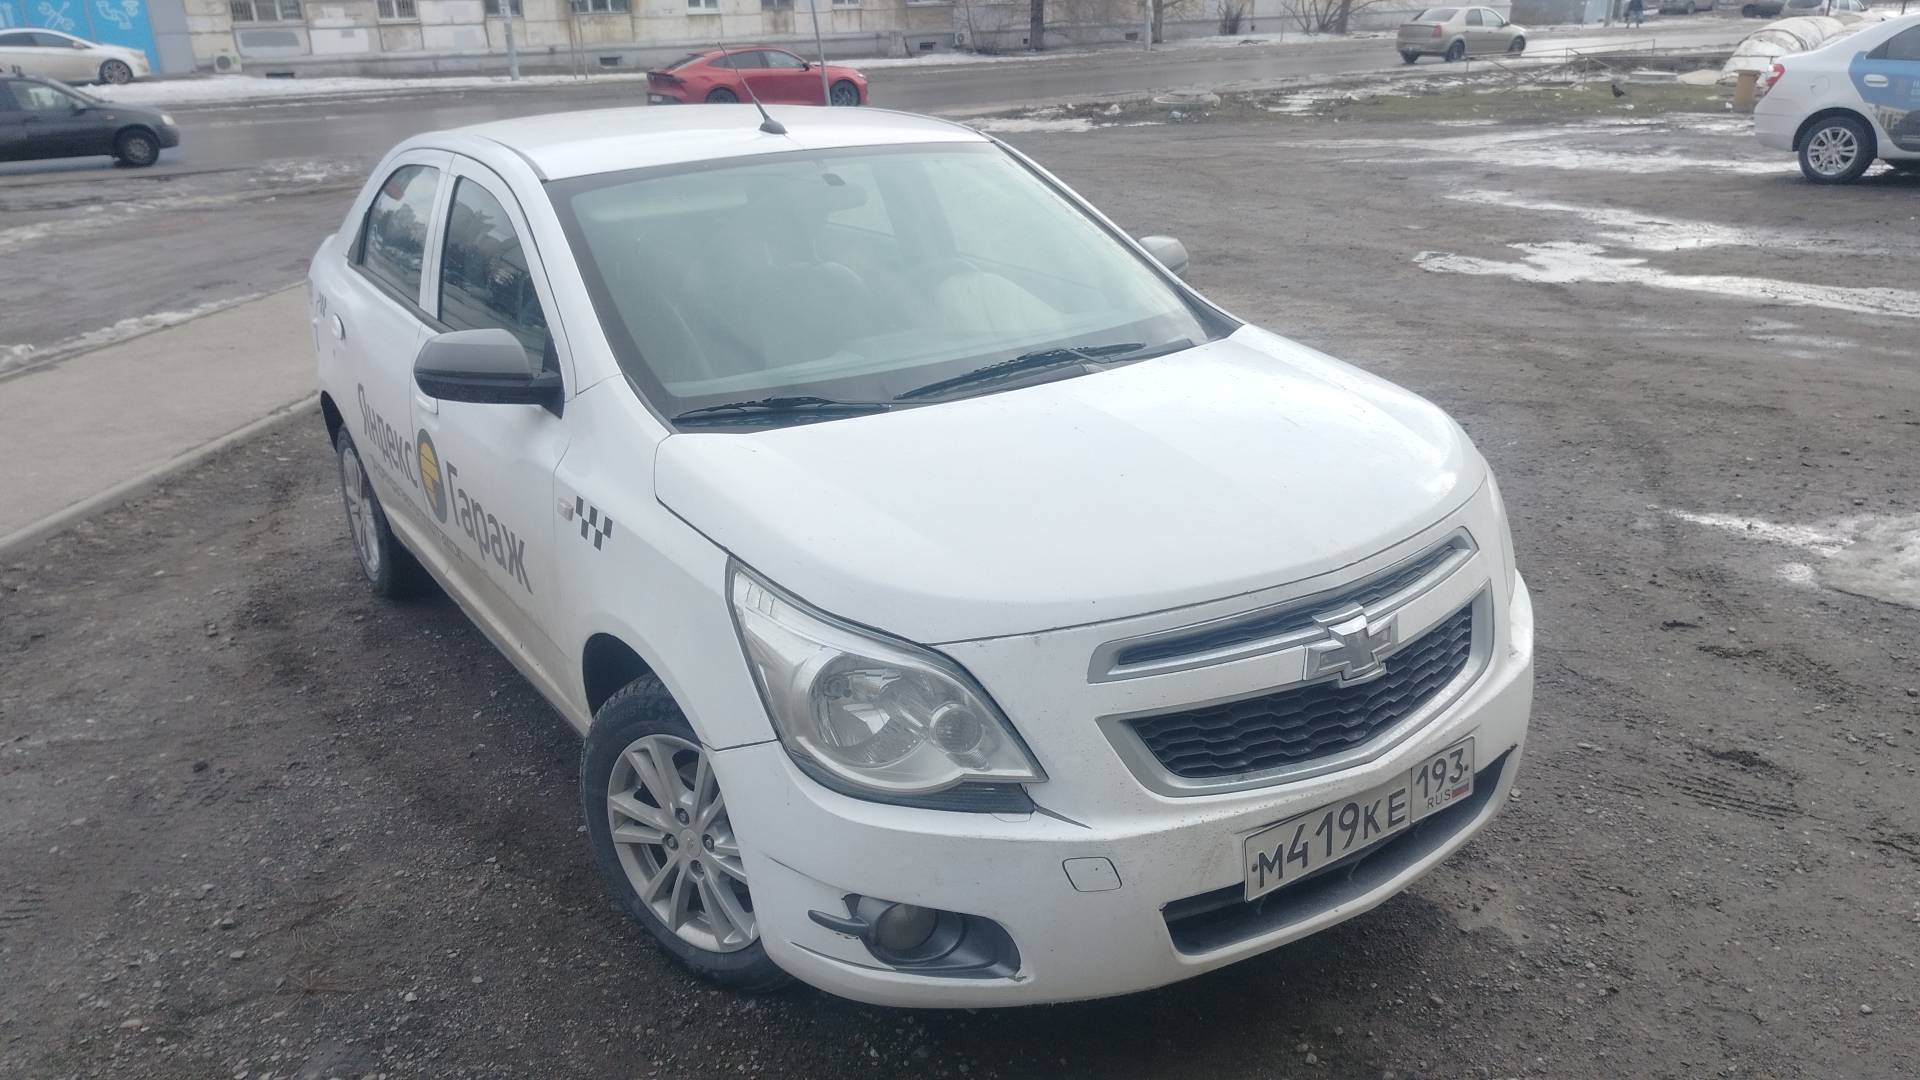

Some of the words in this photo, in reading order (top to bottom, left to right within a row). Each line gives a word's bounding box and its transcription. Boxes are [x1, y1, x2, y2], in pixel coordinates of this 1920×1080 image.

[357, 382, 418, 488] Яндекс
[446, 461, 534, 596] Гараж
[1416, 747, 1464, 798] 193
[1427, 788, 1451, 808] RUS
